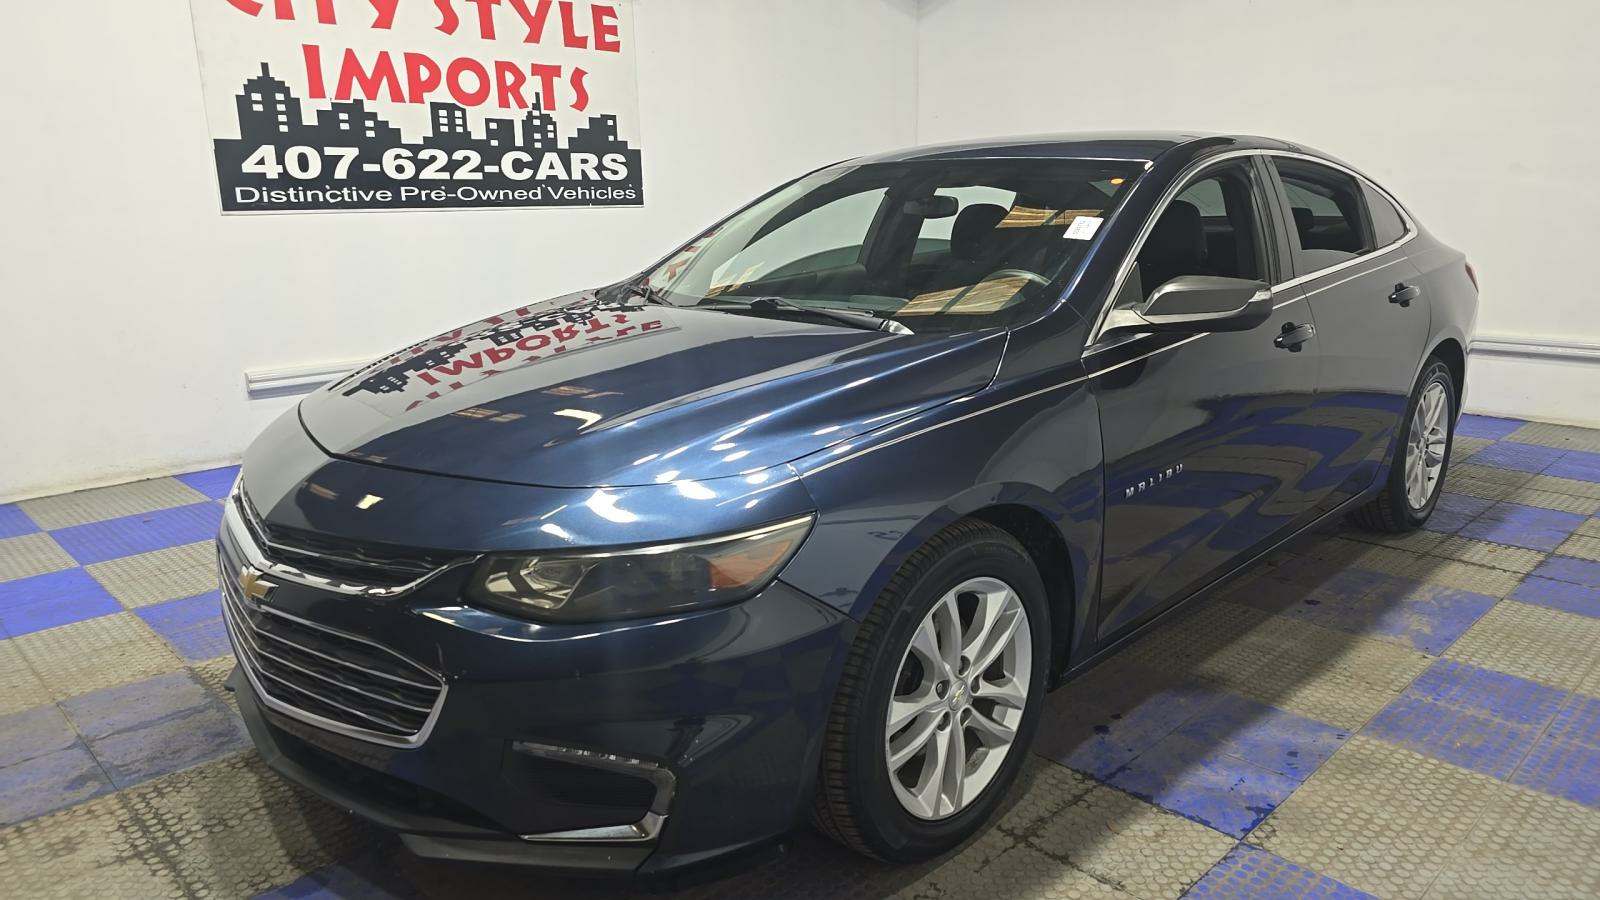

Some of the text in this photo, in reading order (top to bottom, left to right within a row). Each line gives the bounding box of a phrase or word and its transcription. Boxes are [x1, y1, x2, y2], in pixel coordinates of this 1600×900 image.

[434, 0, 621, 53] STYLE
[302, 43, 589, 112] IMPORTS
[241, 144, 628, 181] 407-622-CARS
[235, 186, 637, 203] Distinctive Pre-Owned Vehicles
[1125, 463, 1183, 499] MALIBU
